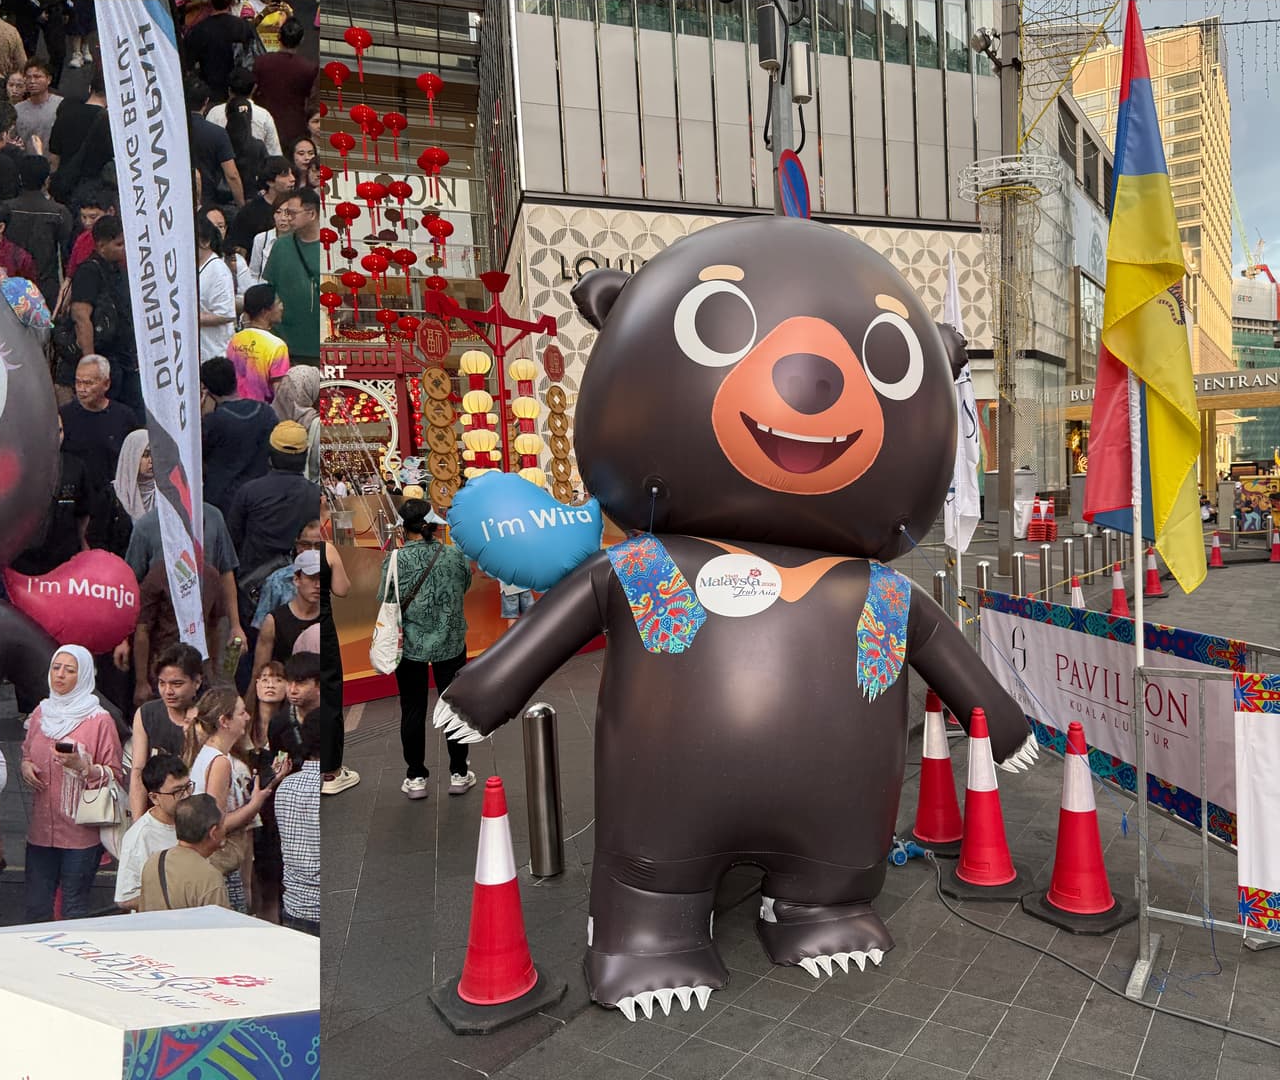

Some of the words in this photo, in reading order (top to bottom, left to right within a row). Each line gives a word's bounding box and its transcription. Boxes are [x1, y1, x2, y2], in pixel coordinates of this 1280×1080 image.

[1201, 372, 1278, 393] ENTRAN
[482, 516, 526, 541] I'm
[528, 507, 593, 529] Wira
[27, 577, 61, 593] I'm
[67, 577, 135, 609] Manja
[699, 576, 761, 591] Malaysia
[732, 586, 758, 598] Truly
[1055, 653, 1190, 728] PAVILON
[1070, 700, 1107, 722] KUALA
[1115, 718, 1170, 750] LUPUR
[21, 932, 213, 995] Malaysia
